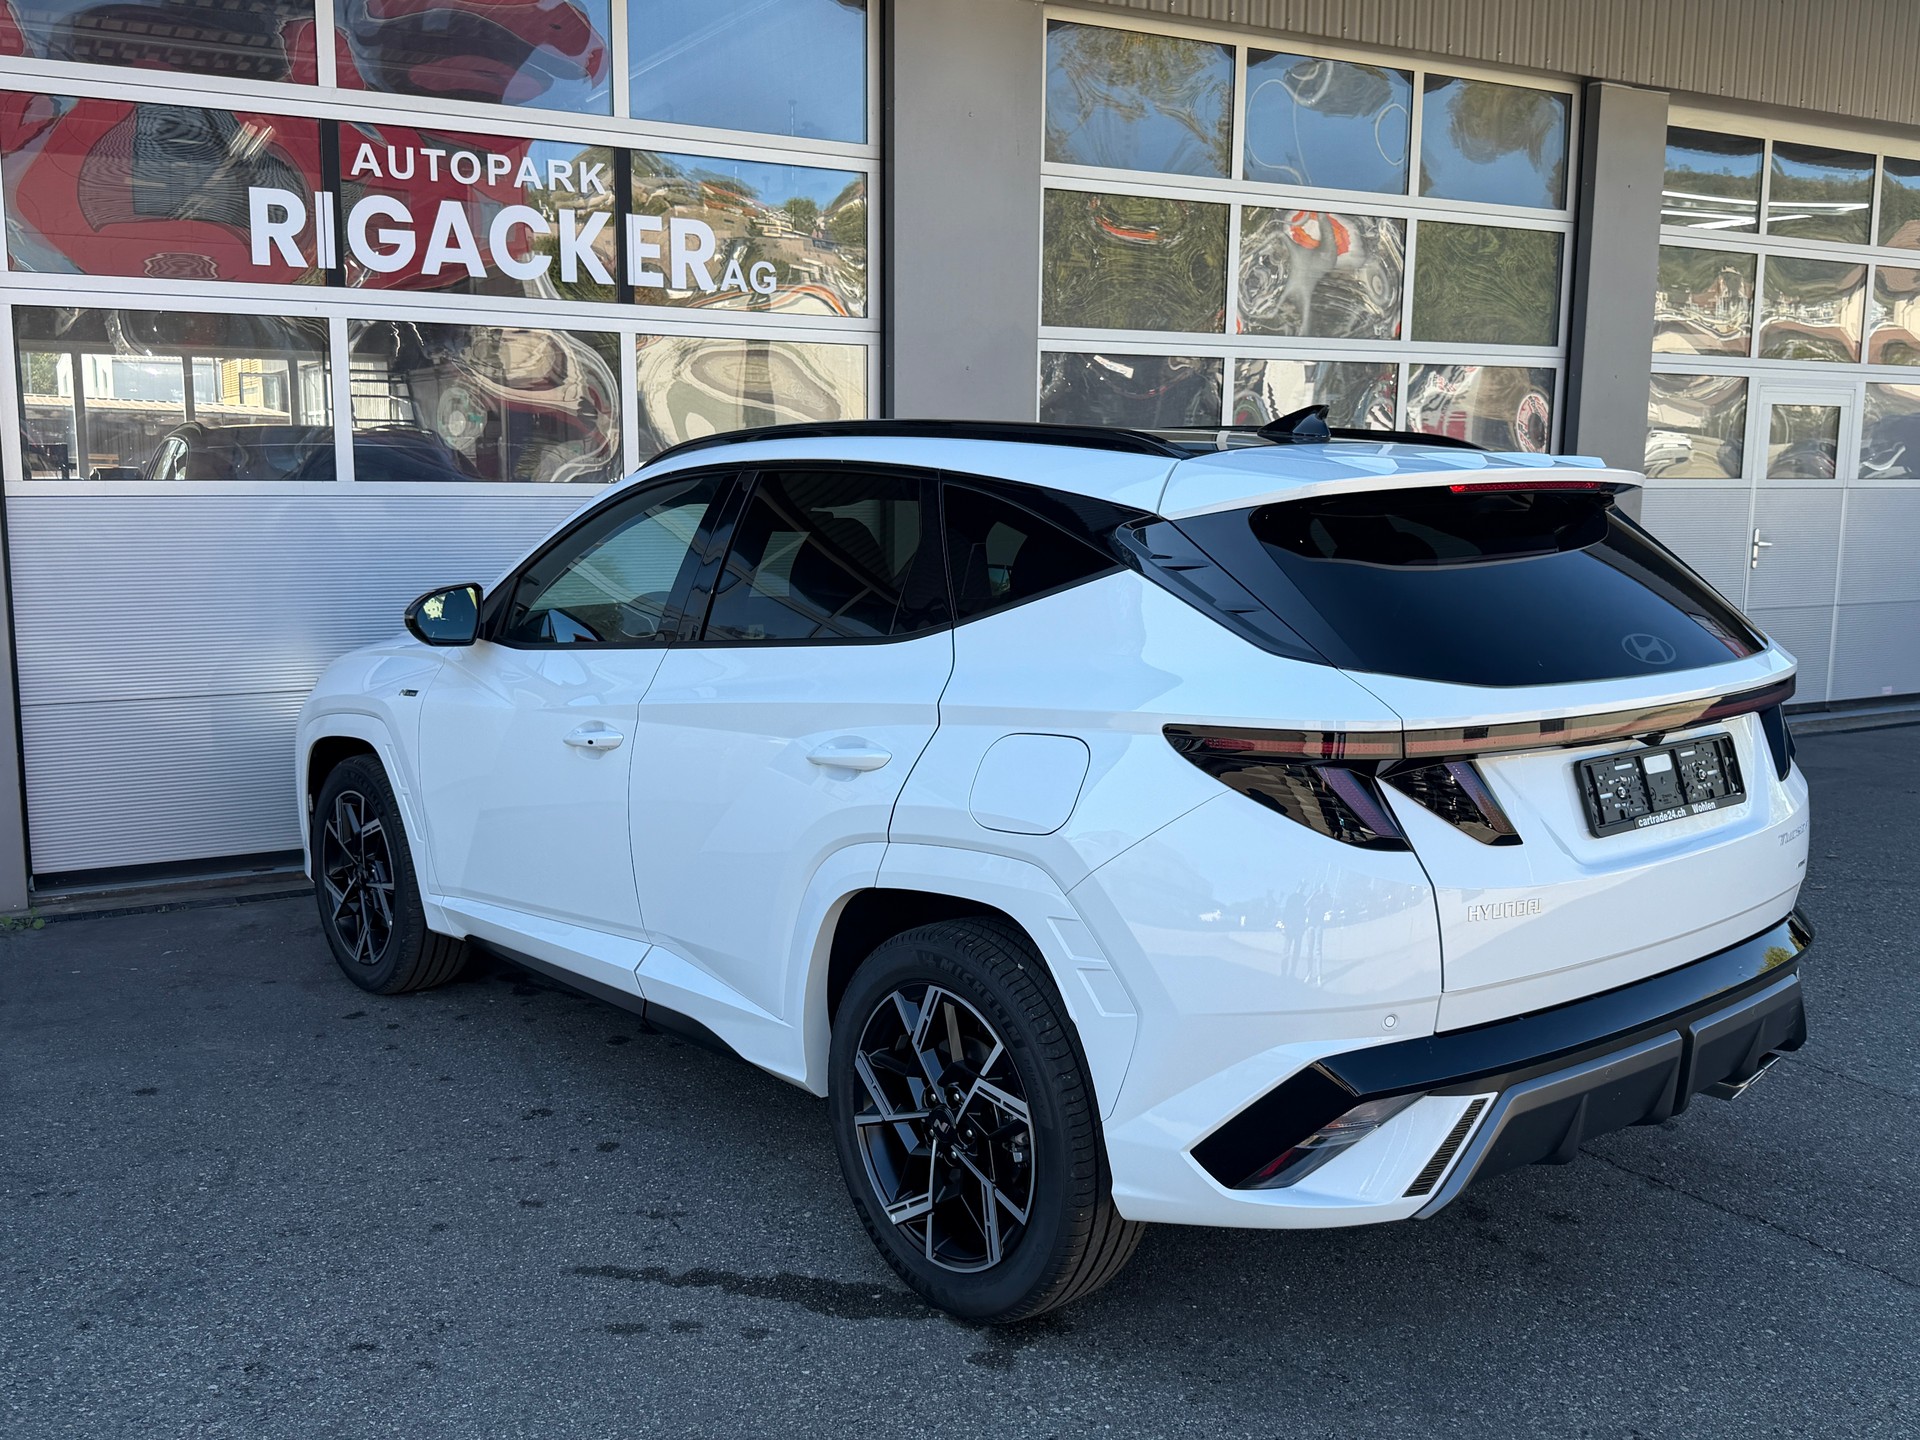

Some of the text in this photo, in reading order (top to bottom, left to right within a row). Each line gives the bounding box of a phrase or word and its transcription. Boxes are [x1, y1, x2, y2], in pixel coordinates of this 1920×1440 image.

[350, 143, 607, 195] AUTOPARK
[248, 186, 777, 294] RIGACKER AG
[1638, 800, 1717, 828] cartrade24.ch Wohlen
[1468, 899, 1541, 922] HYUNDAI
[941, 959, 1022, 1044] MICHELIN
